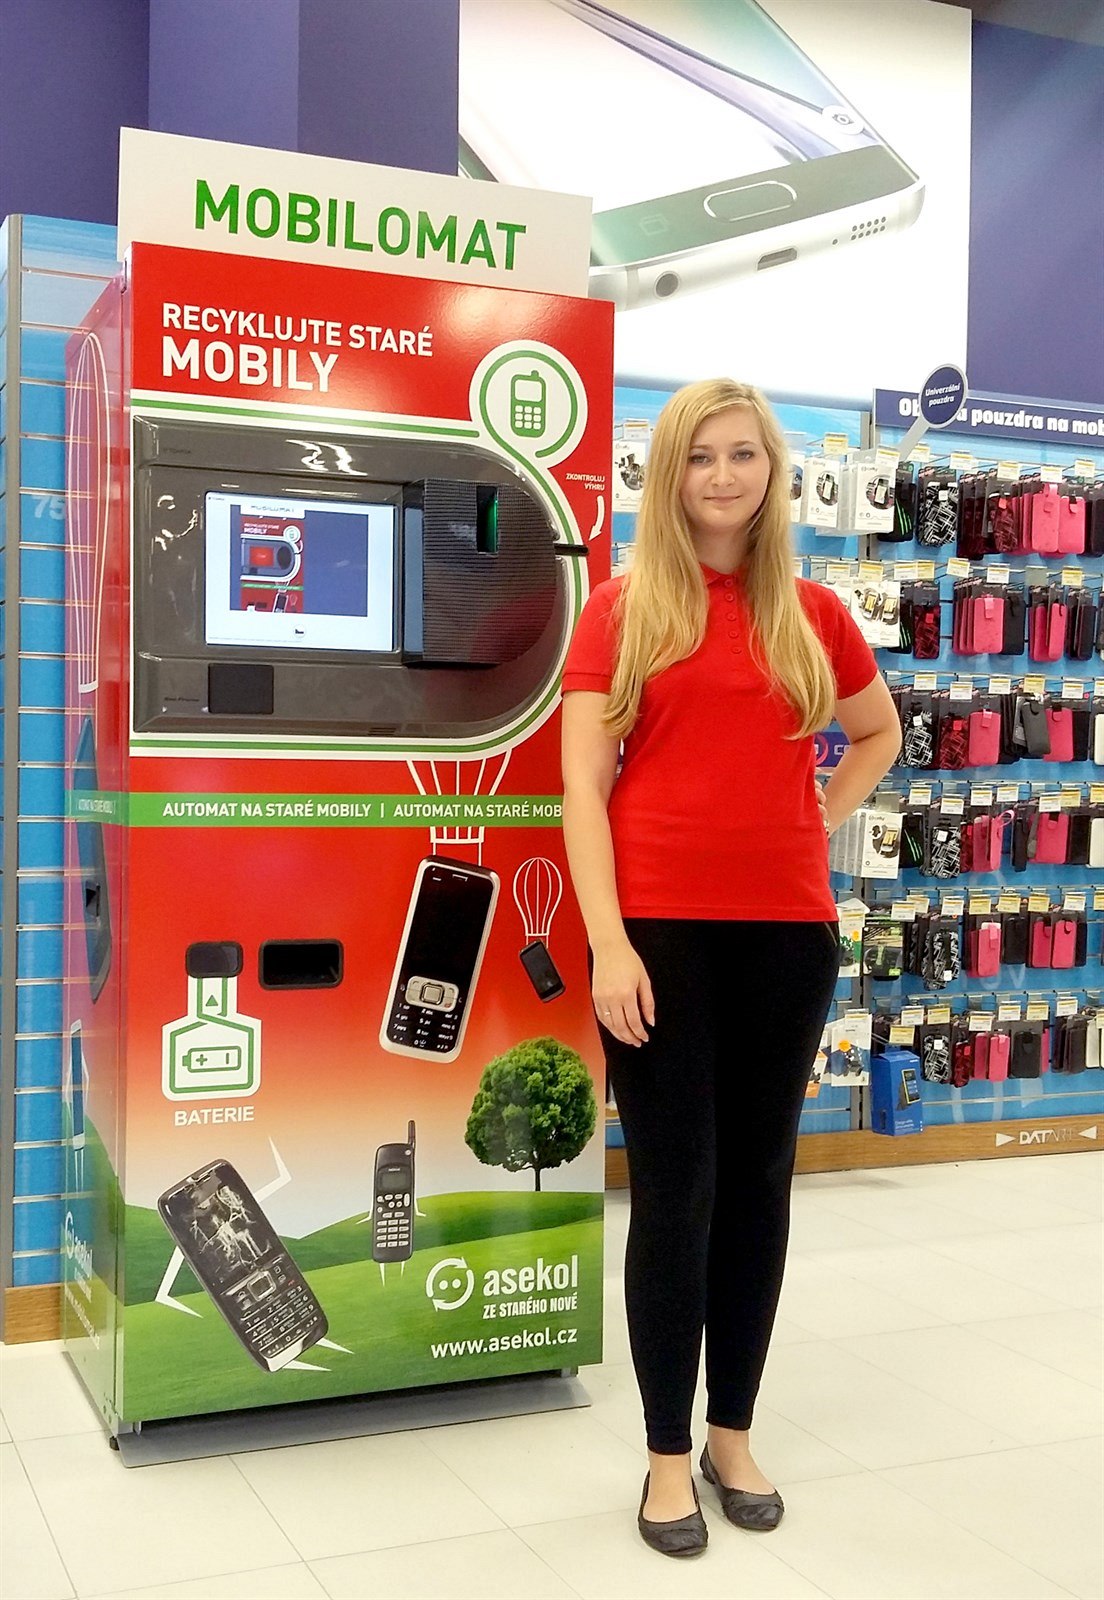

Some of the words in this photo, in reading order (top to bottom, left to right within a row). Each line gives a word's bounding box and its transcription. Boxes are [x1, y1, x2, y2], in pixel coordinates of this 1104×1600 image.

[196, 179, 525, 270] MOBILOMAT
[162, 302, 342, 347] RECYKLUJTE
[348, 324, 433, 357] STARÉ
[162, 336, 339, 392] MOBILY
[925, 383, 961, 397] Univerzální
[928, 396, 955, 407] pouzdra
[971, 408, 1044, 430] pouzdra
[1046, 417, 1069, 433] na
[565, 473, 605, 483] ZKONTROLUJ
[584, 482, 605, 491] VÝHRU
[162, 803, 238, 818] AUTOMAT
[241, 803, 263, 817] NA
[265, 800, 313, 817] STARÉ
[316, 803, 372, 818] MOBILY
[393, 804, 461, 818] AUTOMAT
[464, 804, 484, 817] NA
[486, 801, 530, 817] STARÉ
[174, 1106, 255, 1126] BATERIE
[482, 1254, 579, 1297] asekol
[482, 1304, 497, 1320] ZE
[499, 1295, 548, 1318] STARÉHO
[549, 1291, 578, 1313] NOVÉ
[430, 1326, 578, 1359] www.asekol.cz
